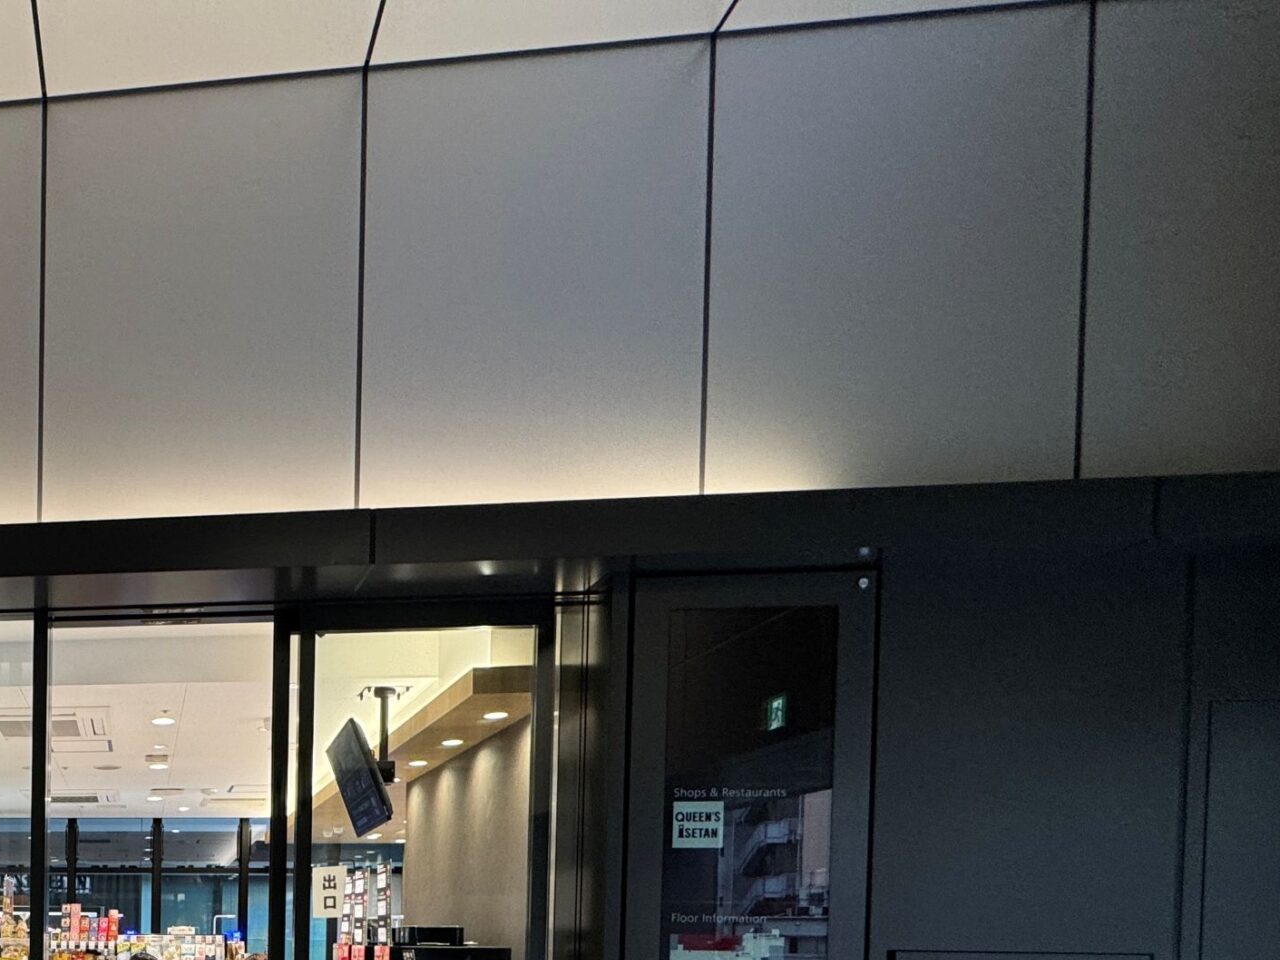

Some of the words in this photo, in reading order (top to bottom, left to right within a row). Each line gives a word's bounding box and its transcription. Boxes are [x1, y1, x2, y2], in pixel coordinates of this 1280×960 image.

[673, 787, 706, 798] Shops
[710, 788, 718, 797] &
[722, 787, 787, 797] Restaurants
[675, 811, 721, 822] QUEEN'S
[677, 824, 718, 838] ISETAN
[322, 874, 337, 909] 出口
[671, 913, 698, 923] Floor
[702, 913, 767, 924] Information
